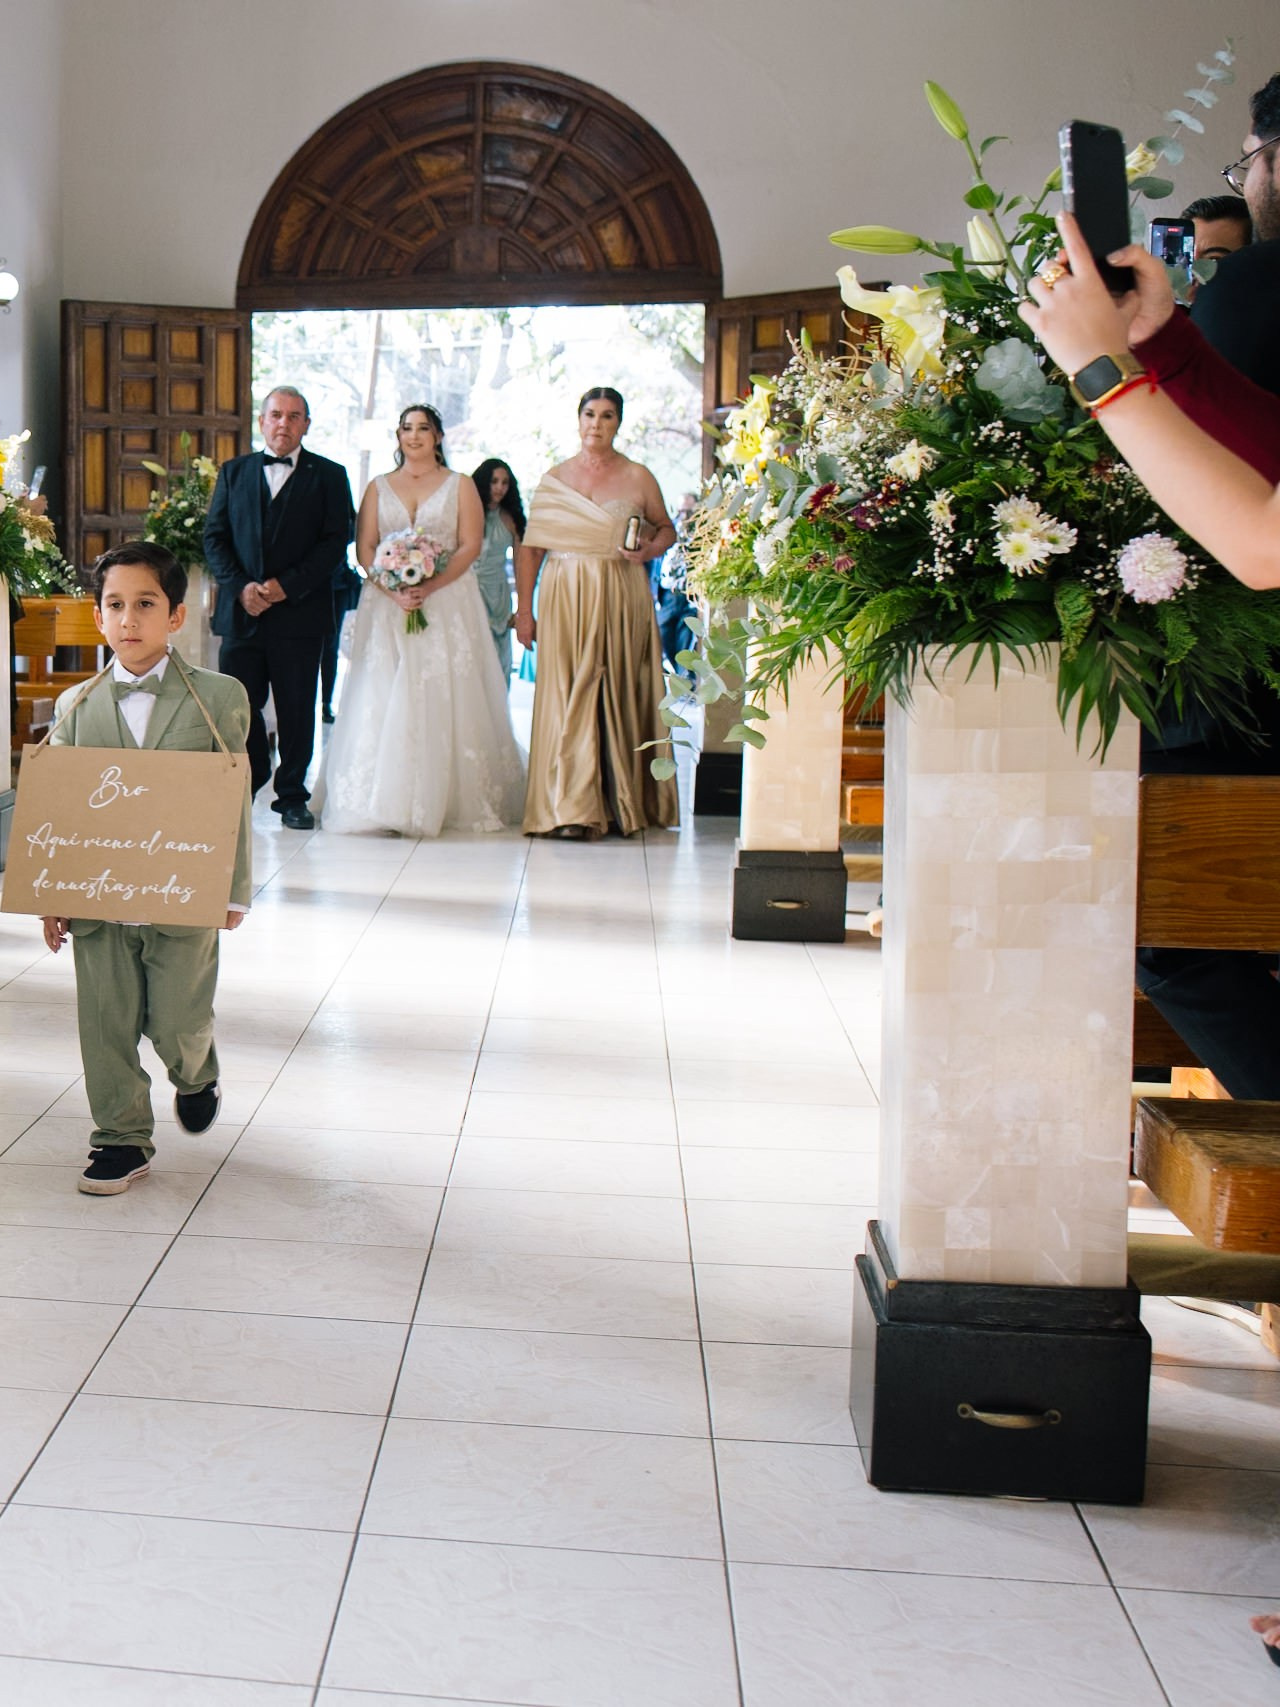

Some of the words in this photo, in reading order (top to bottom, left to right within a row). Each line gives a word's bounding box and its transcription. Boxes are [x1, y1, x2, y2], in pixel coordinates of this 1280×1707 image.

[88, 765, 150, 809] Bro
[83, 835, 136, 850] viene
[139, 830, 162, 856] el
[164, 840, 217, 854] amor
[32, 868, 54, 898] de
[56, 868, 140, 901] nuestras
[141, 874, 197, 904] vidas
